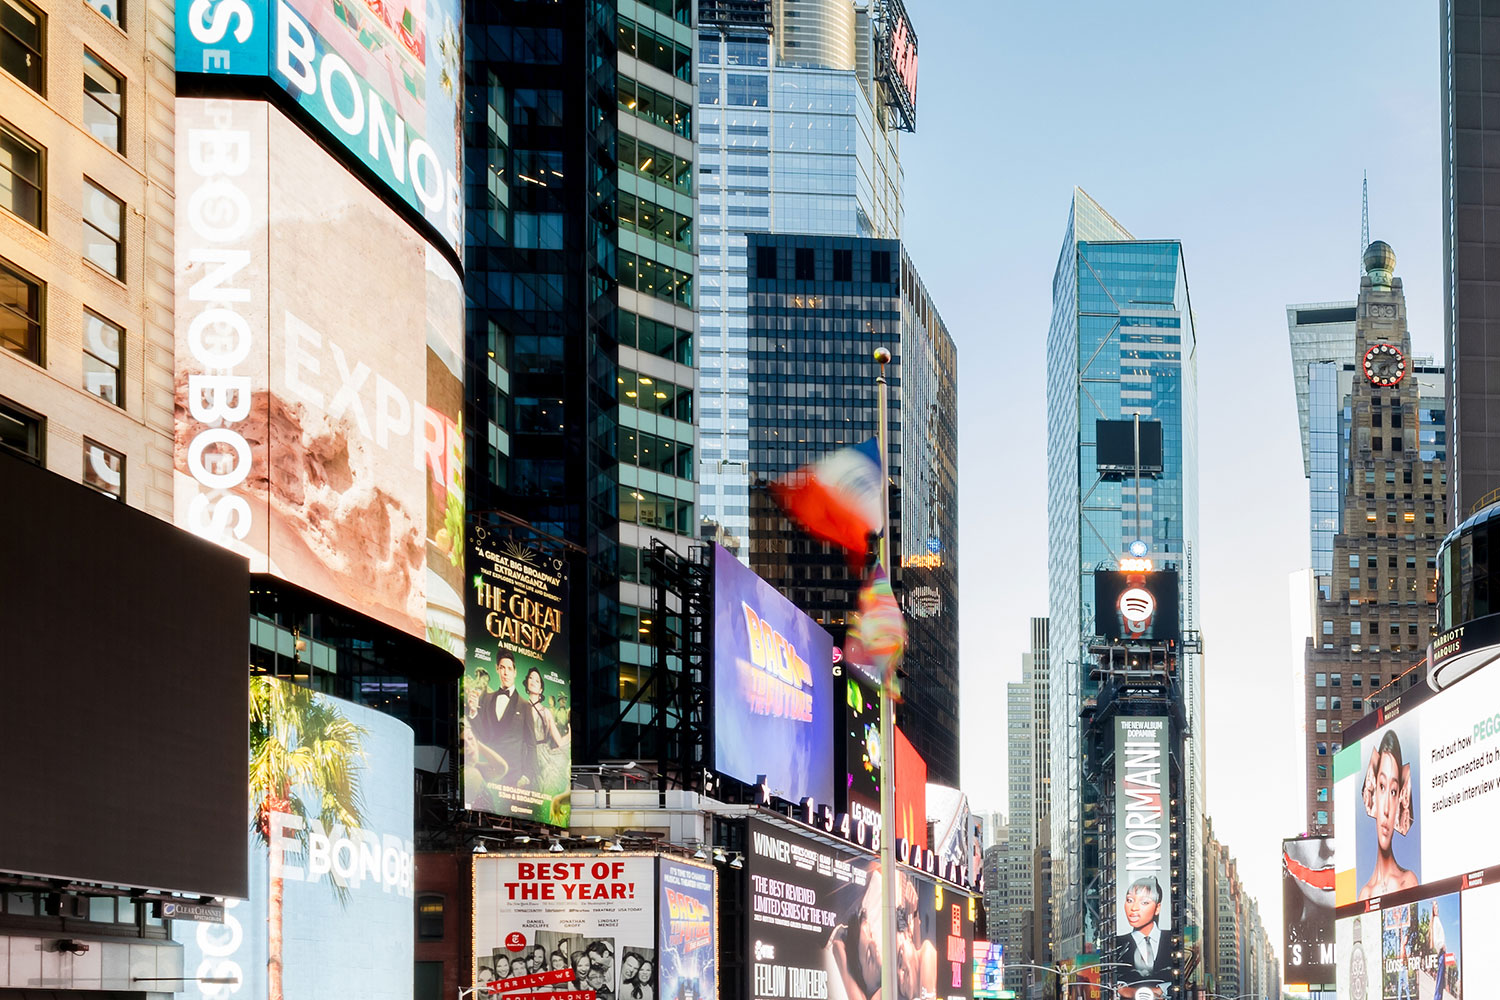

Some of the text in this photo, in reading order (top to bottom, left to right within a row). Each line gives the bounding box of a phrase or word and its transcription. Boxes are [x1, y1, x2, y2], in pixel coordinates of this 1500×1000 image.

[188, 128, 252, 541] BONOBOS
[494, 563, 548, 591] EXTRAVAGANZA
[510, 560, 522, 571] BIG
[523, 565, 561, 586] BROADWAY
[476, 581, 564, 633] THE GREAT
[486, 612, 554, 653] GATSBY
[1433, 627, 1465, 649] MARRIOTT
[504, 643, 518, 653] NEW
[518, 647, 545, 661] MUSICAL
[1433, 641, 1461, 662] MARQUIS
[1121, 721, 1162, 729] THE NEW ALBUM
[1127, 729, 1156, 737] DOPAMINE
[1431, 745, 1445, 764] Find
[1445, 741, 1456, 757] out
[1457, 735, 1472, 752] how
[1431, 772, 1449, 789] stays
[1449, 756, 1485, 781] connected
[1485, 752, 1494, 765] to
[852, 801, 862, 818] LG
[1125, 741, 1162, 872] NORMANI
[1432, 792, 1461, 813] exclusive
[1462, 779, 1494, 801] interview
[807, 797, 866, 846] 1540
[753, 832, 791, 864] WINNER
[518, 862, 625, 880] BEST OF
[504, 883, 635, 900] THE YEAR!
[768, 879, 786, 898] BEST
[785, 884, 816, 906] REVIEWED
[754, 895, 780, 915] LIMITED
[780, 901, 801, 920] SERIES
[801, 906, 810, 921] OF
[810, 908, 821, 925] THE
[555, 971, 570, 979] WE
[1408, 954, 1438, 970] FOR LIFE
[754, 963, 828, 1000] FELLOW TRAVELERS
